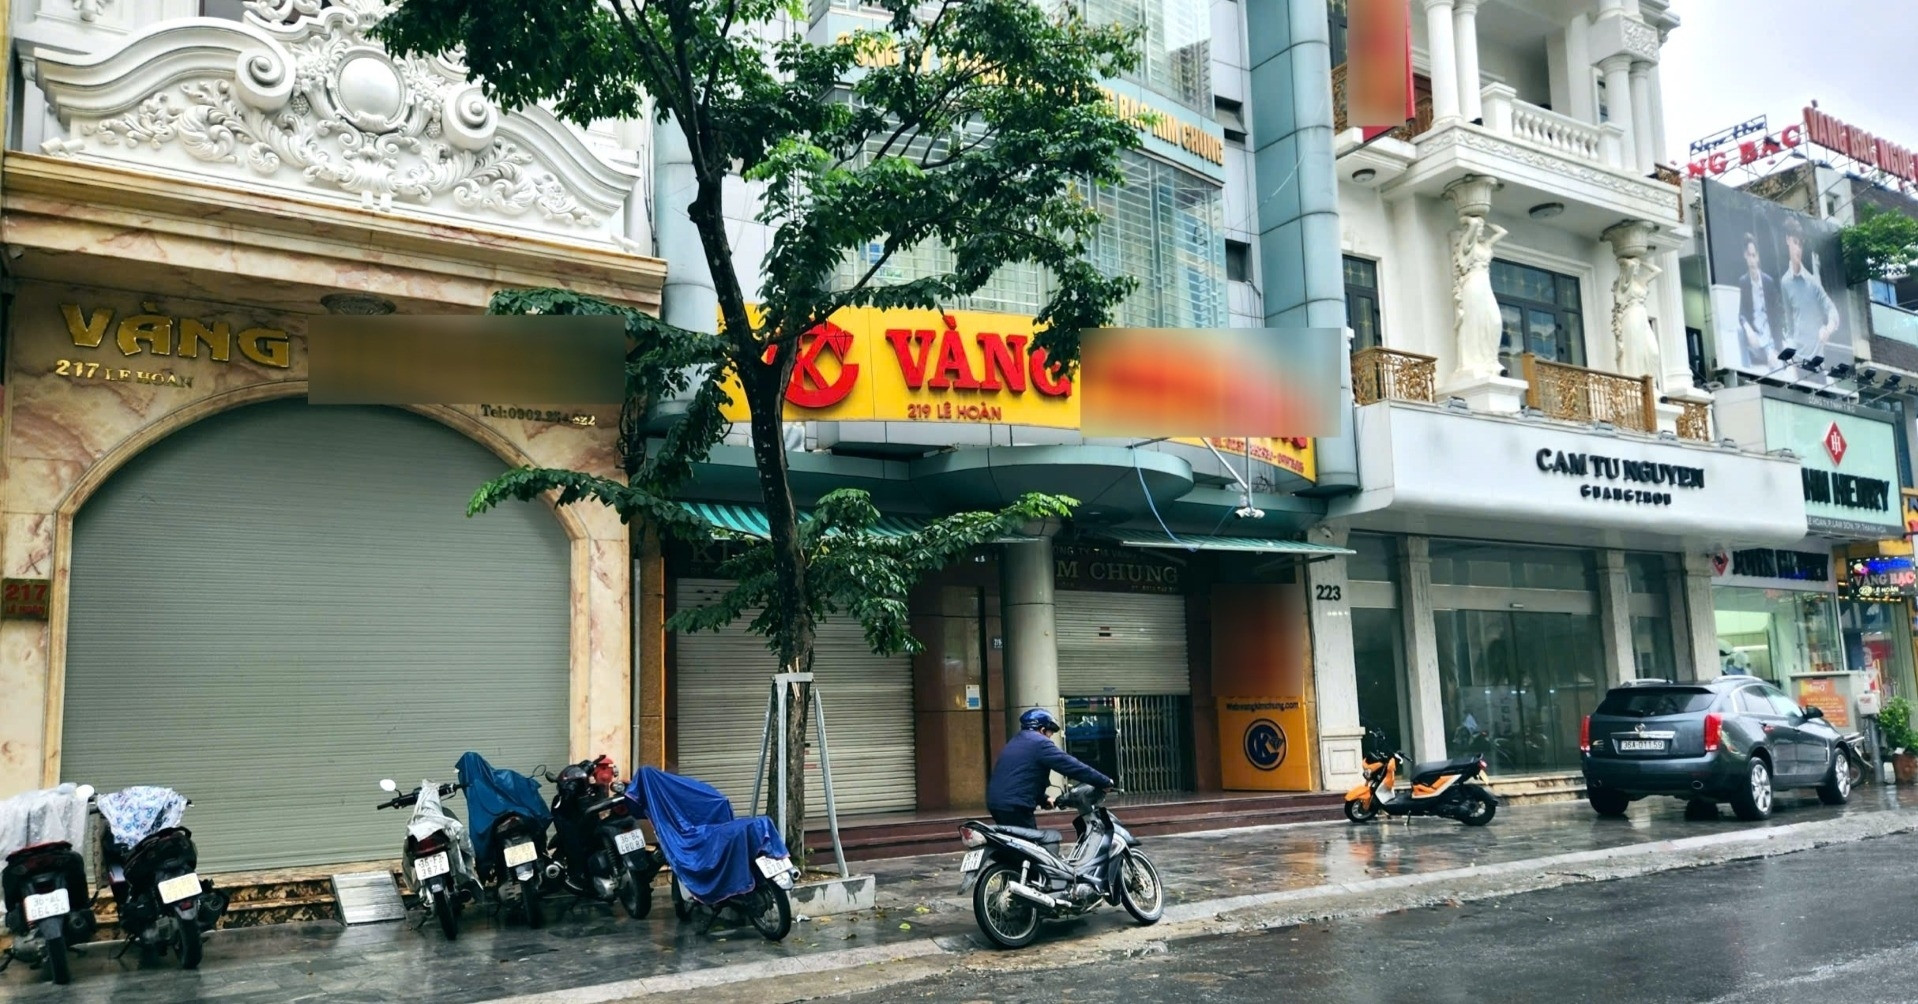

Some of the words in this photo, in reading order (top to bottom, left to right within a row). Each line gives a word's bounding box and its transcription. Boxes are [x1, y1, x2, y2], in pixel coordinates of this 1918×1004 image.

[1181, 122, 1224, 166] CHUNG
[1687, 151, 1728, 179] NG
[59, 301, 290, 368] VÀNG
[56, 359, 99, 379] 217
[886, 315, 1072, 399] VÀNG
[907, 402, 932, 420] 219
[936, 400, 953, 420] LÊ
[957, 401, 1002, 422] HOÀN
[1589, 455, 1620, 480] TU
[1623, 459, 1705, 489] NGUYEN
[1089, 561, 1178, 583] CHUNG
[5, 584, 48, 601] 217
[1316, 584, 1342, 601] 223
